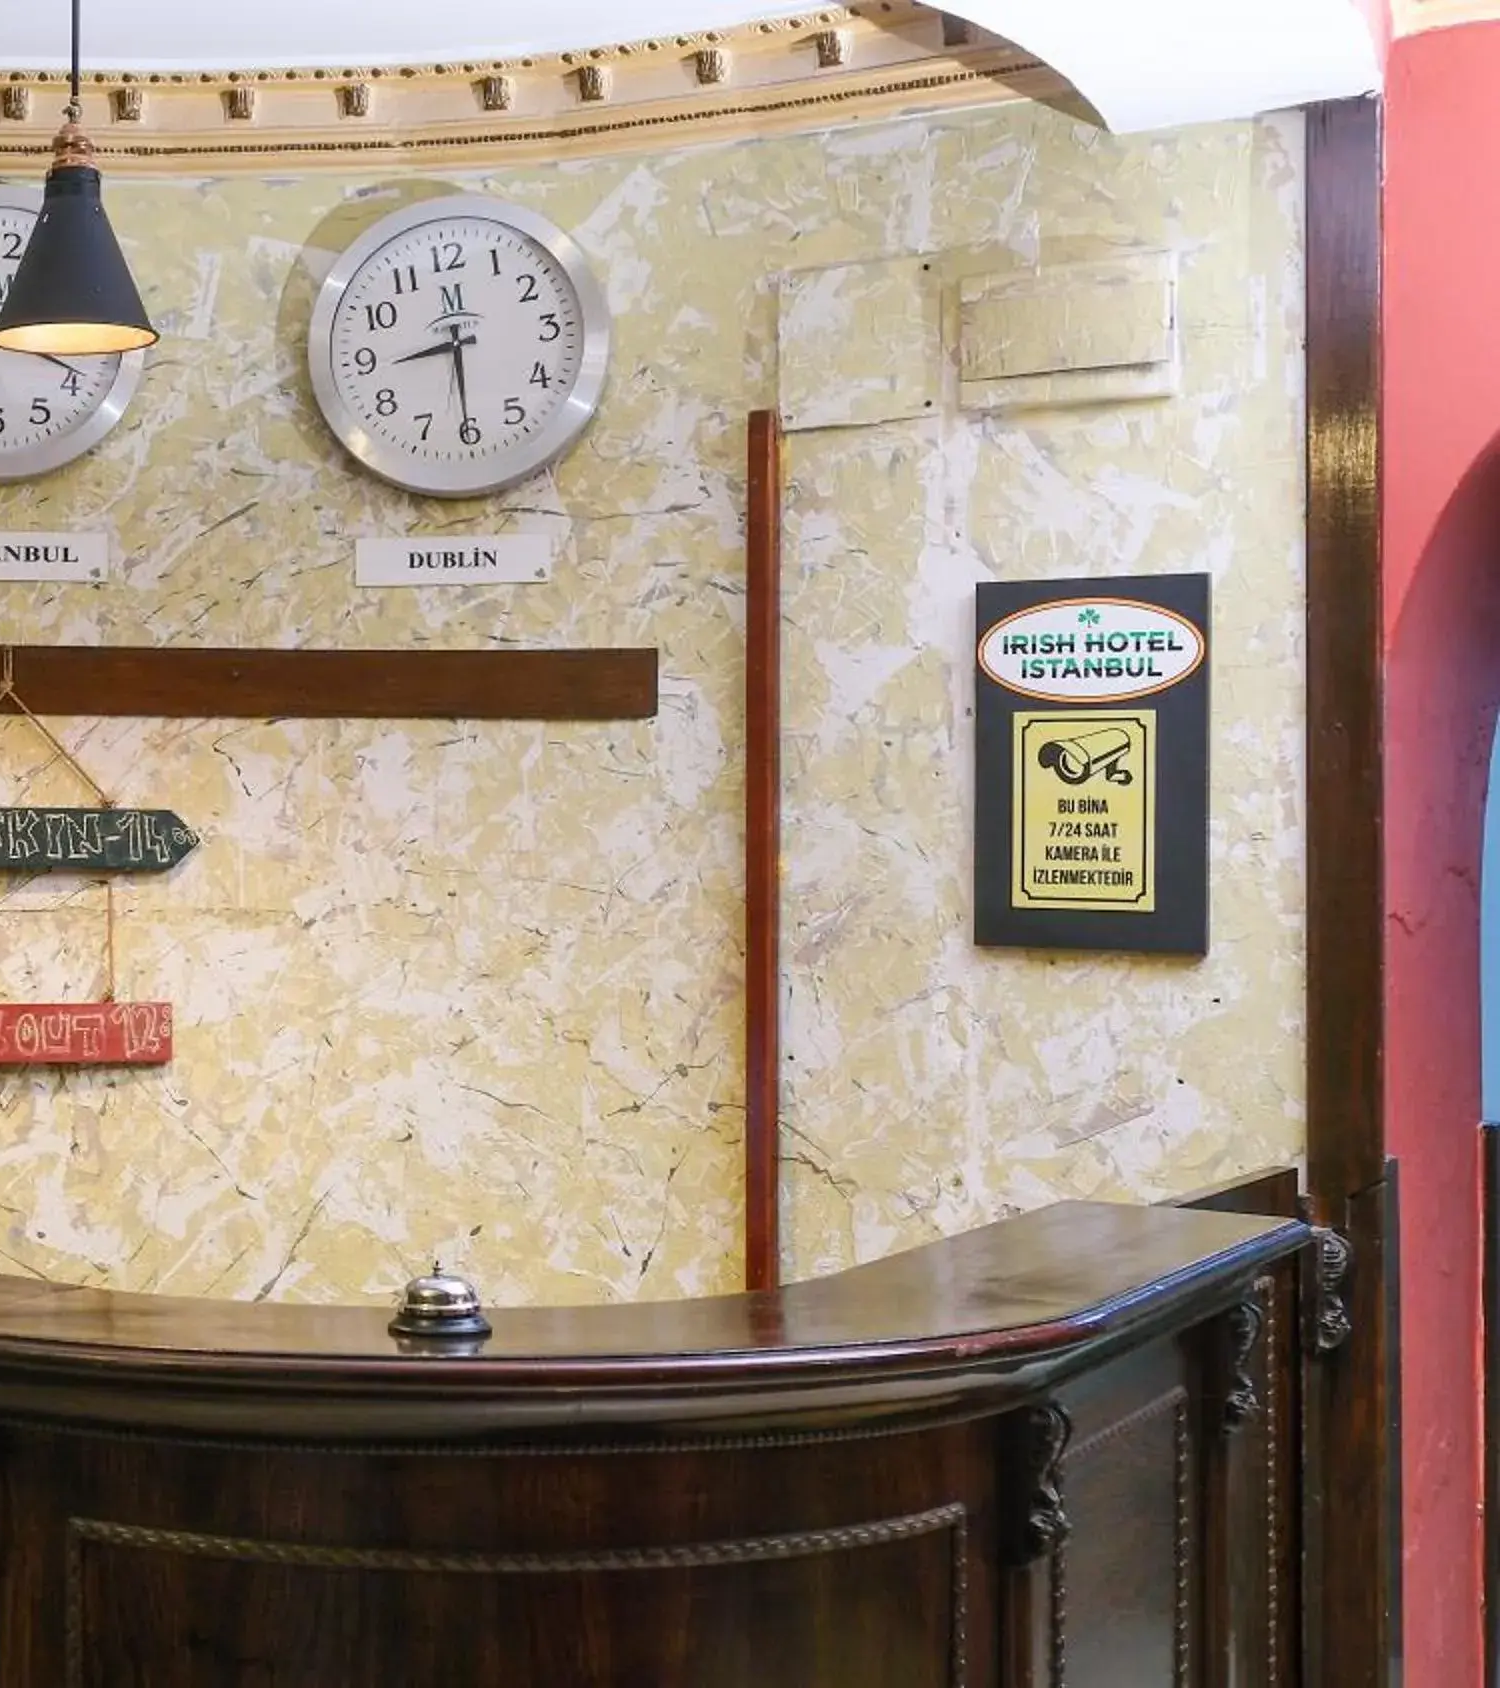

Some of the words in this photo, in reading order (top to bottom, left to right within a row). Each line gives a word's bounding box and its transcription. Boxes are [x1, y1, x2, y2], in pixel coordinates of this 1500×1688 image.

[430, 242, 466, 273] 12
[489, 249, 501, 276] 1
[393, 265, 420, 295] 11
[516, 274, 539, 303] 2
[365, 301, 397, 331] 10
[539, 313, 561, 342] 3
[354, 347, 377, 375] 9
[60, 371, 80, 396] 4
[529, 361, 551, 389] 4
[29, 397, 50, 424] 5
[375, 388, 398, 416] 8
[503, 397, 526, 425] 5
[413, 413, 433, 441] 7
[459, 418, 481, 445] 6
[408, 547, 498, 569] DUBLİN
[1003, 634, 1075, 655] IRISH
[1085, 631, 1183, 653] HOTEL
[1021, 656, 1163, 679] ISTANBUL
[1057, 798, 1075, 814] BU
[1078, 796, 1109, 814] BİNA
[1048, 821, 1082, 837] 7/24
[1085, 822, 1118, 838] SAAT
[1045, 845, 1099, 861] KAMERA
[1101, 843, 1122, 863] İLE
[1033, 865, 1133, 886] İZLENMEKTEDİR
